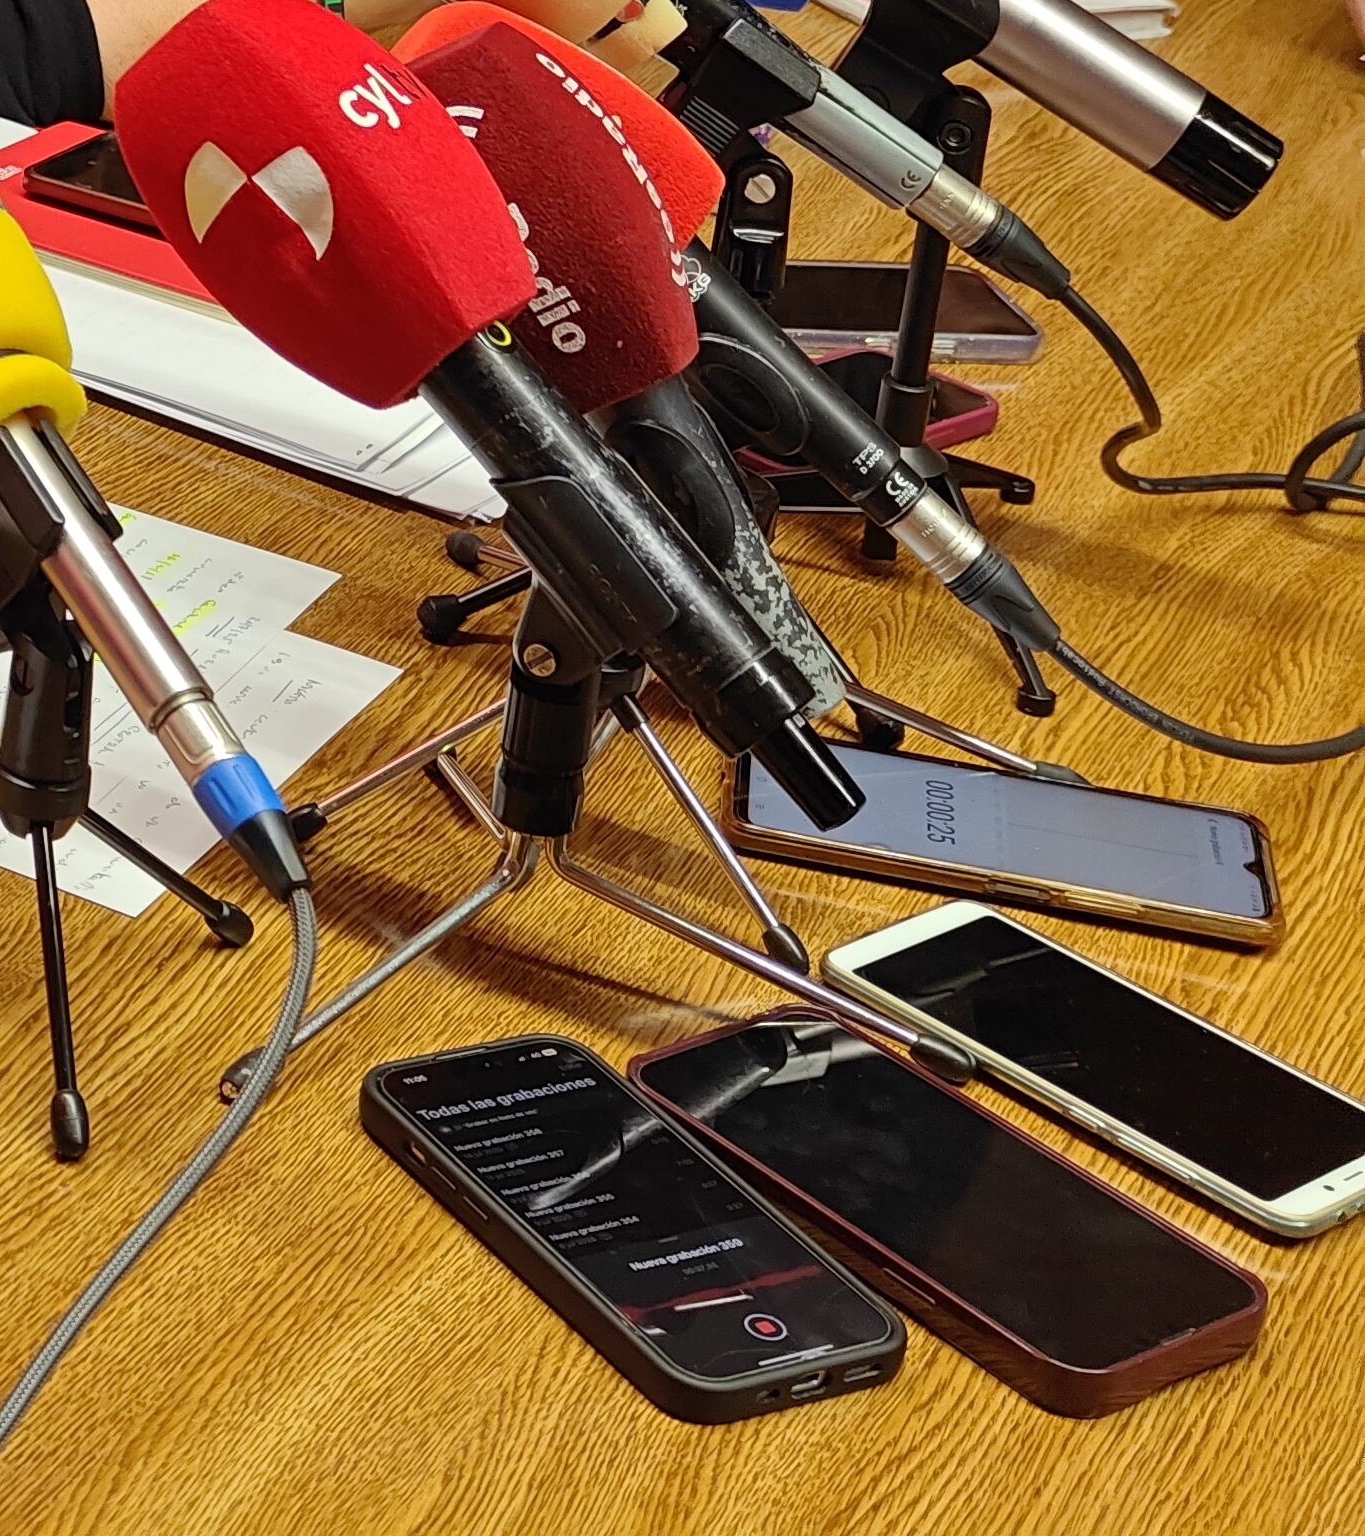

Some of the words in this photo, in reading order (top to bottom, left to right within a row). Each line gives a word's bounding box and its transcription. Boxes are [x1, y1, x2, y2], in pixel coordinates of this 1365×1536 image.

[924, 779, 956, 846] 00:00:25
[416, 1104, 470, 1121] Todas
[469, 1098, 497, 1112] las
[496, 1077, 597, 1107] grabaciones
